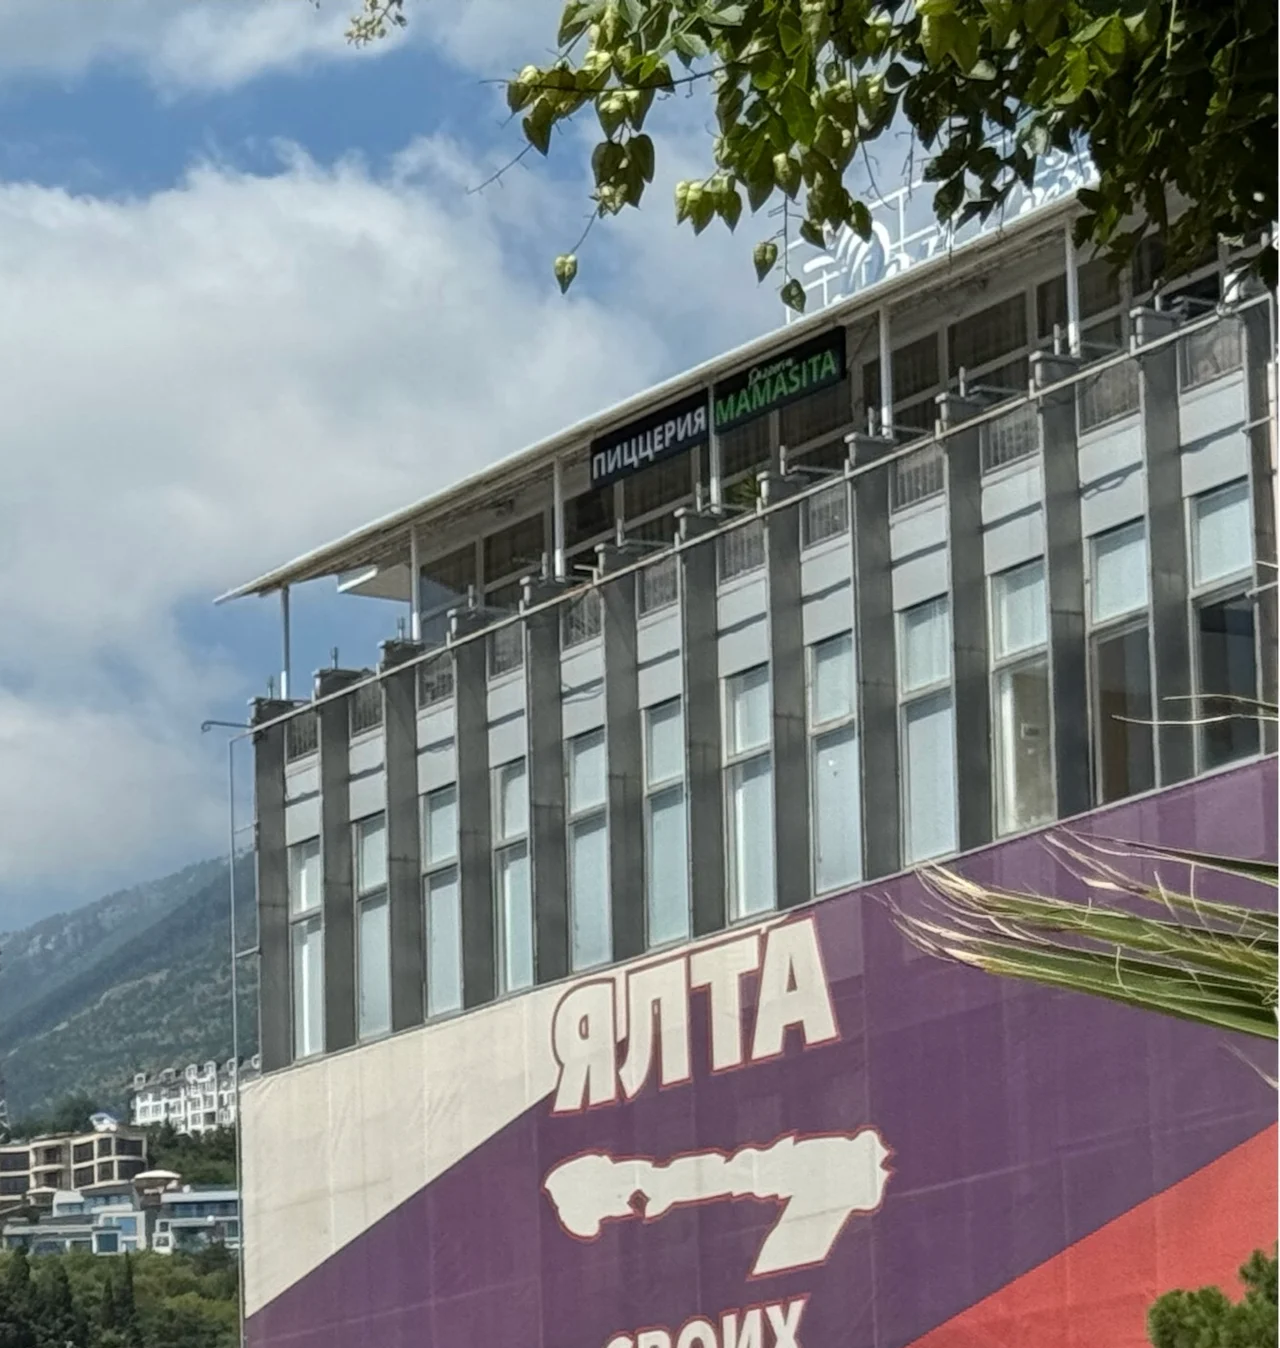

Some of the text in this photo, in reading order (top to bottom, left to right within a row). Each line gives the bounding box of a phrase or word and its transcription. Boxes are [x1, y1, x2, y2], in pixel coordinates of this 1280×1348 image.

[715, 350, 837, 427] MAMASITA
[593, 405, 707, 480] ПИЦЦЕРИЯ
[551, 915, 840, 1114] ЯЛТА
